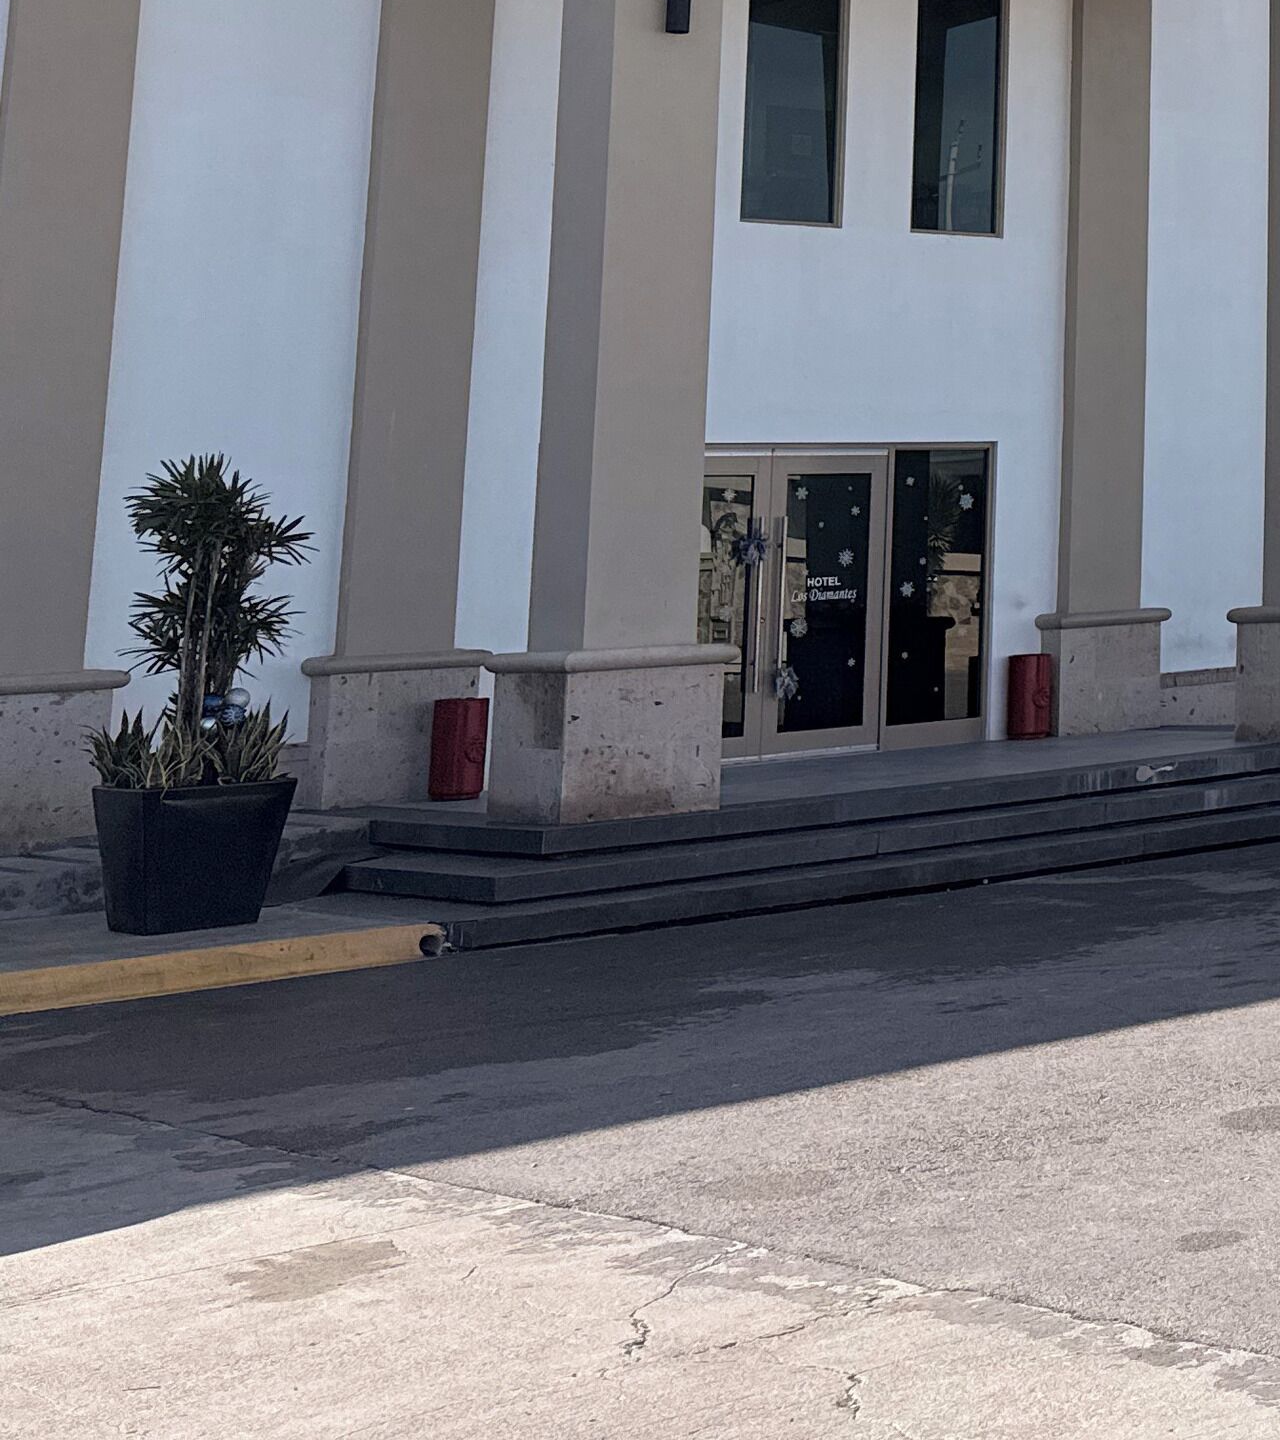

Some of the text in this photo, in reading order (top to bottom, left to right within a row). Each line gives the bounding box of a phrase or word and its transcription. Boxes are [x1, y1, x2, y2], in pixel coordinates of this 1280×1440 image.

[807, 576, 841, 587] HOTEL
[791, 588, 857, 603] Los Diamantes
